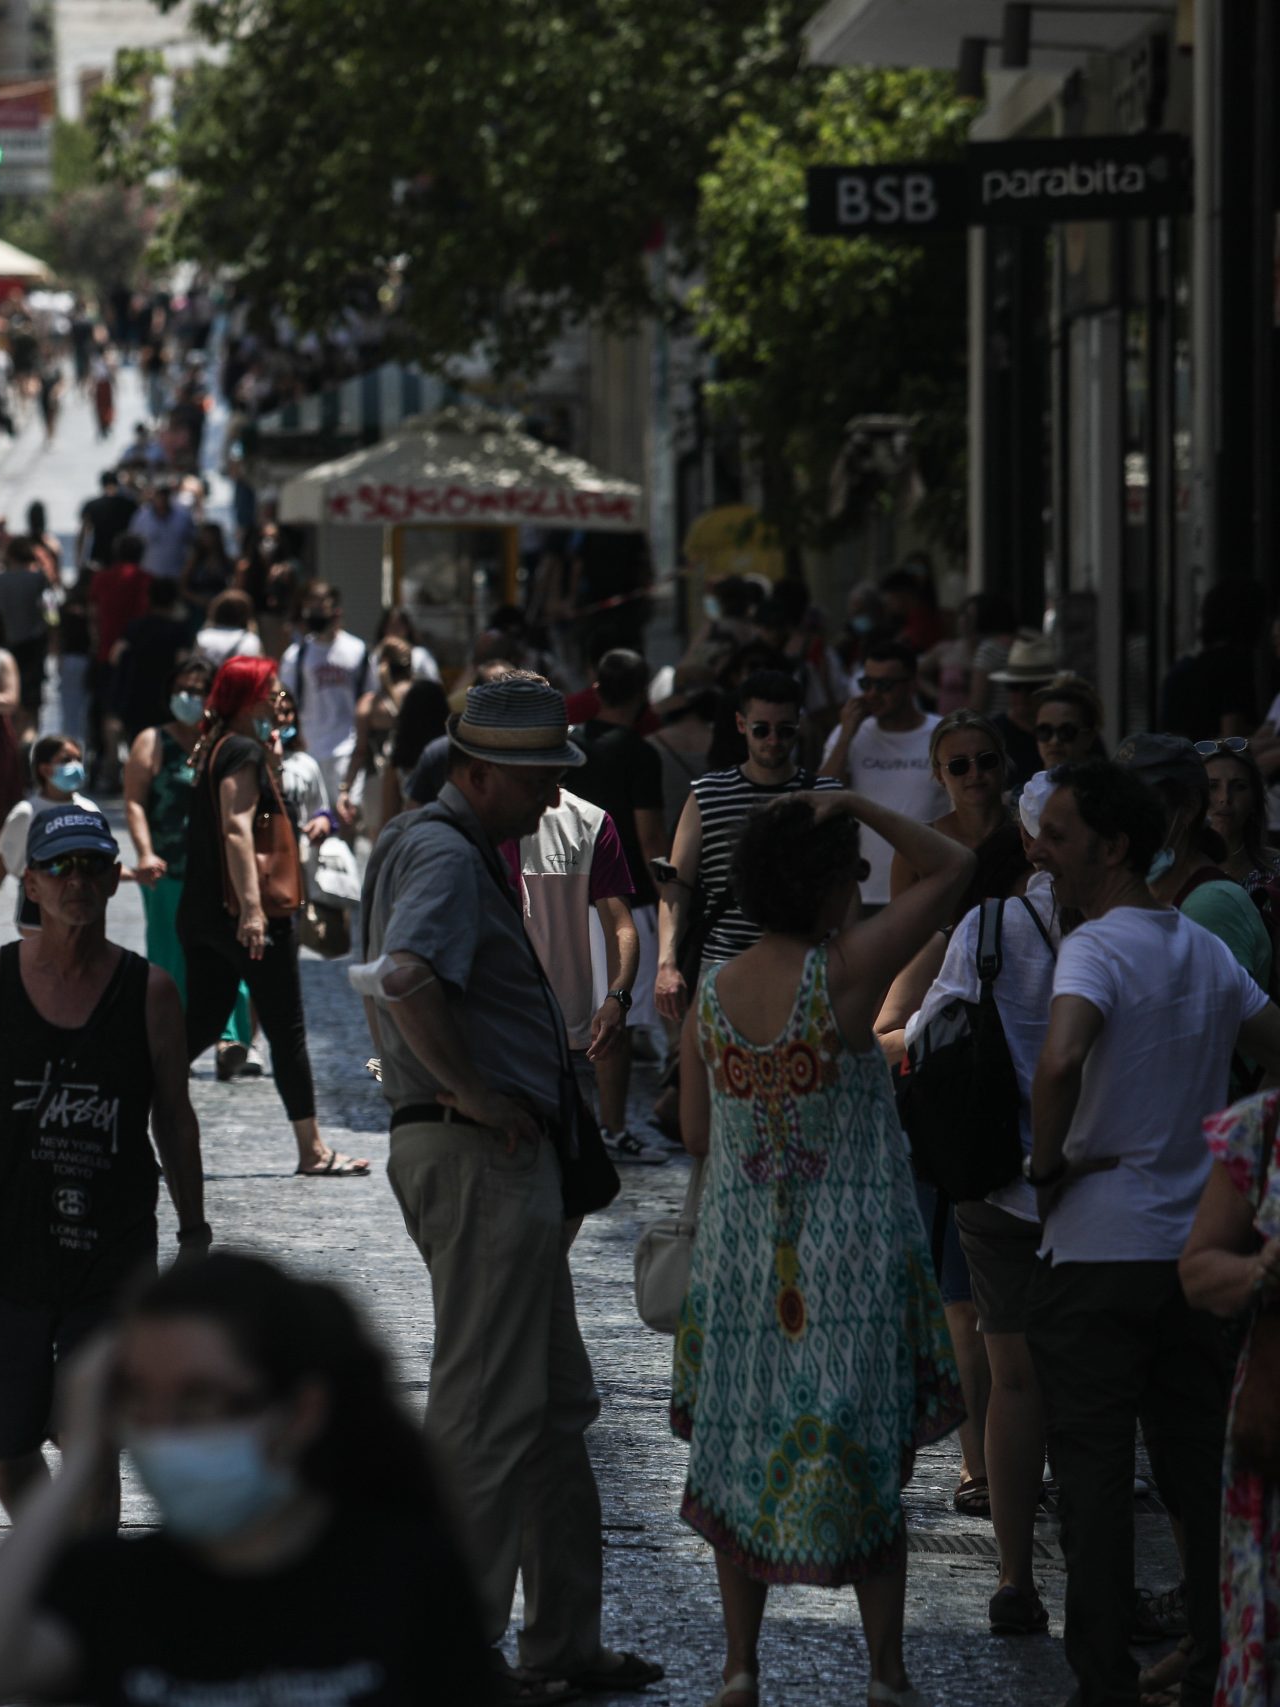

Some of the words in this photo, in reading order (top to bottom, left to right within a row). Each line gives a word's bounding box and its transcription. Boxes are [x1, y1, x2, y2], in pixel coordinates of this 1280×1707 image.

[981, 161, 1147, 205] parabita
[835, 174, 939, 226] BSB
[45, 815, 104, 835] GREECE
[39, 1135, 69, 1149] NEW
[70, 1139, 104, 1154] YORK
[31, 1149, 56, 1161] LOS
[57, 1150, 113, 1169] ANGELES
[52, 1163, 94, 1179] TOKYO
[49, 1224, 99, 1240] LONDON
[59, 1236, 93, 1251] PARIS
